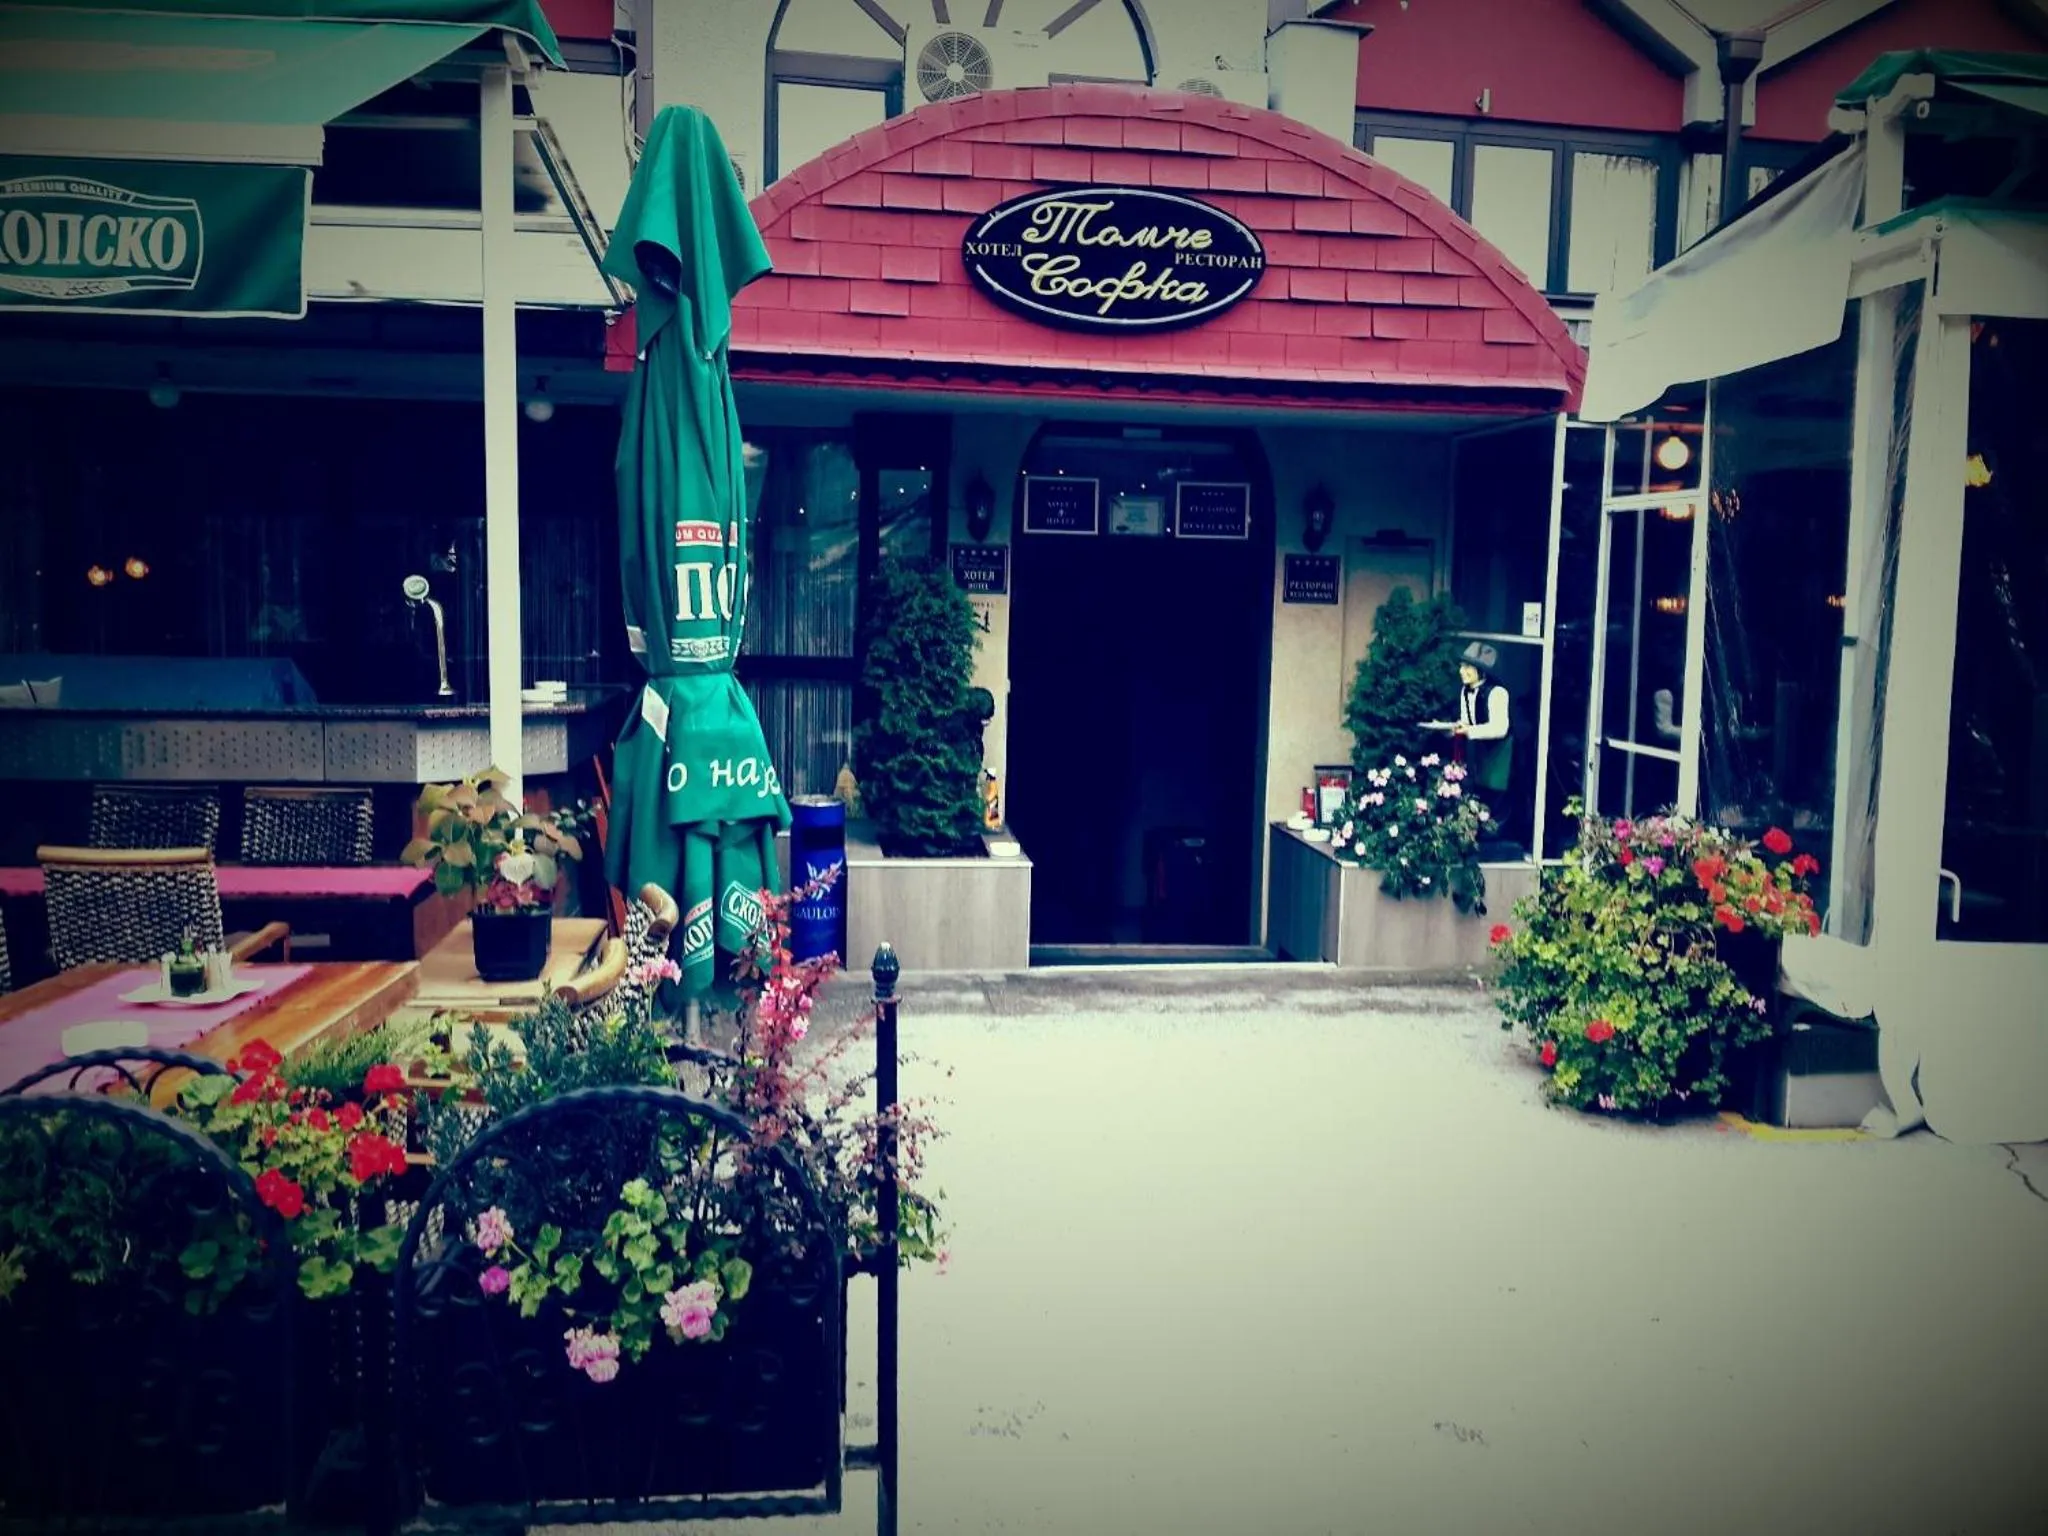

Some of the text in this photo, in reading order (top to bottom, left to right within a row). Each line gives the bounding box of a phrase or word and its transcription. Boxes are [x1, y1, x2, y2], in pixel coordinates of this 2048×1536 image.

[4, 181, 123, 200] PREMIUM QUALITY
[1021, 200, 1214, 249] Томче
[965, 240, 1023, 258] ХОТЕЛ
[1174, 251, 1263, 270] РЕСТОРАН
[1020, 252, 1209, 316] Софка
[963, 569, 995, 582] ХОТЕЛ
